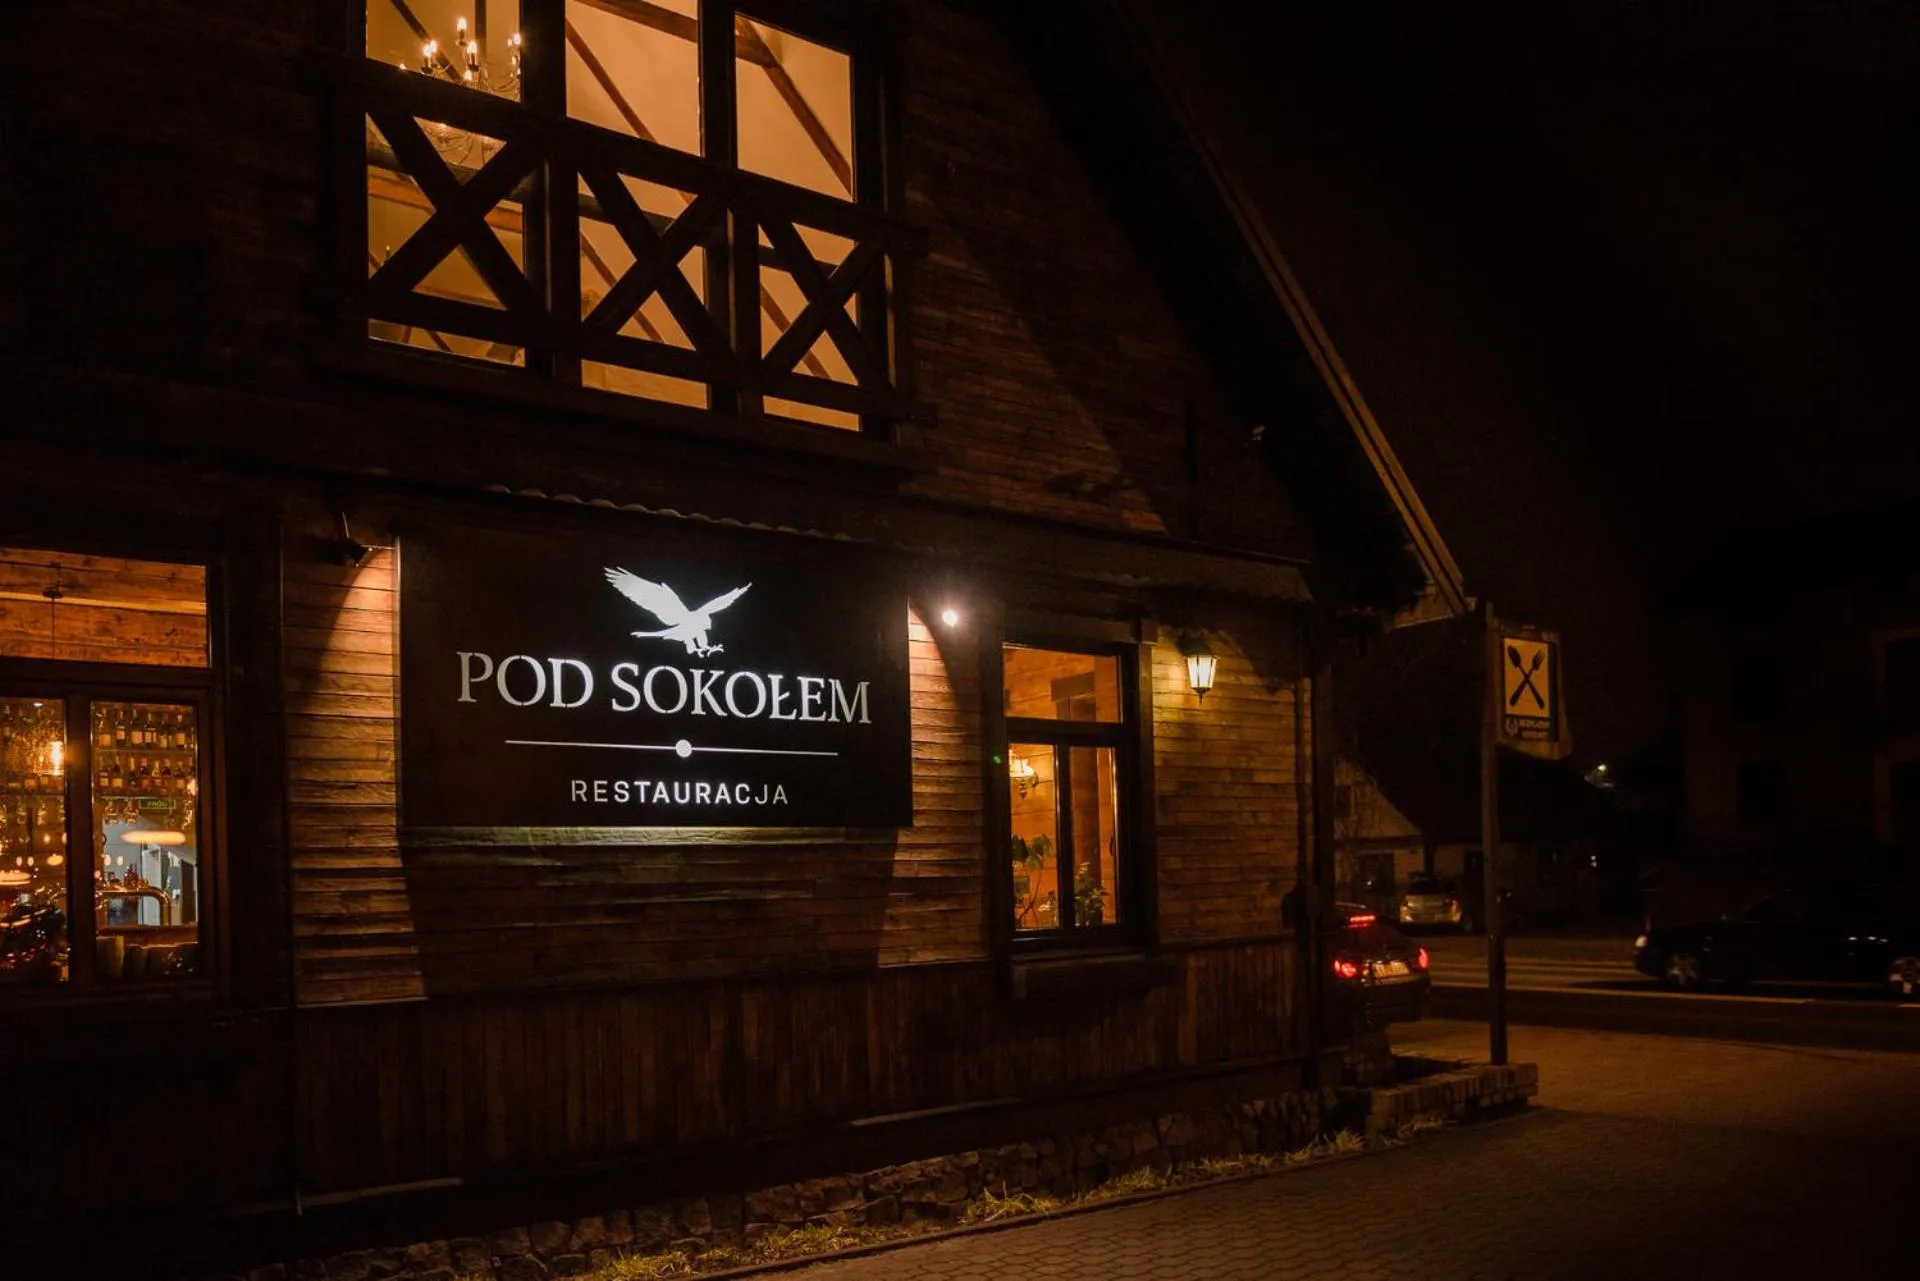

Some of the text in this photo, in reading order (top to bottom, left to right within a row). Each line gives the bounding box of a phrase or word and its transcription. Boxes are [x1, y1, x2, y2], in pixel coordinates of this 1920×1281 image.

[456, 651, 871, 724] POD SOKOŁEM
[571, 779, 788, 804] RESTAURACJA
